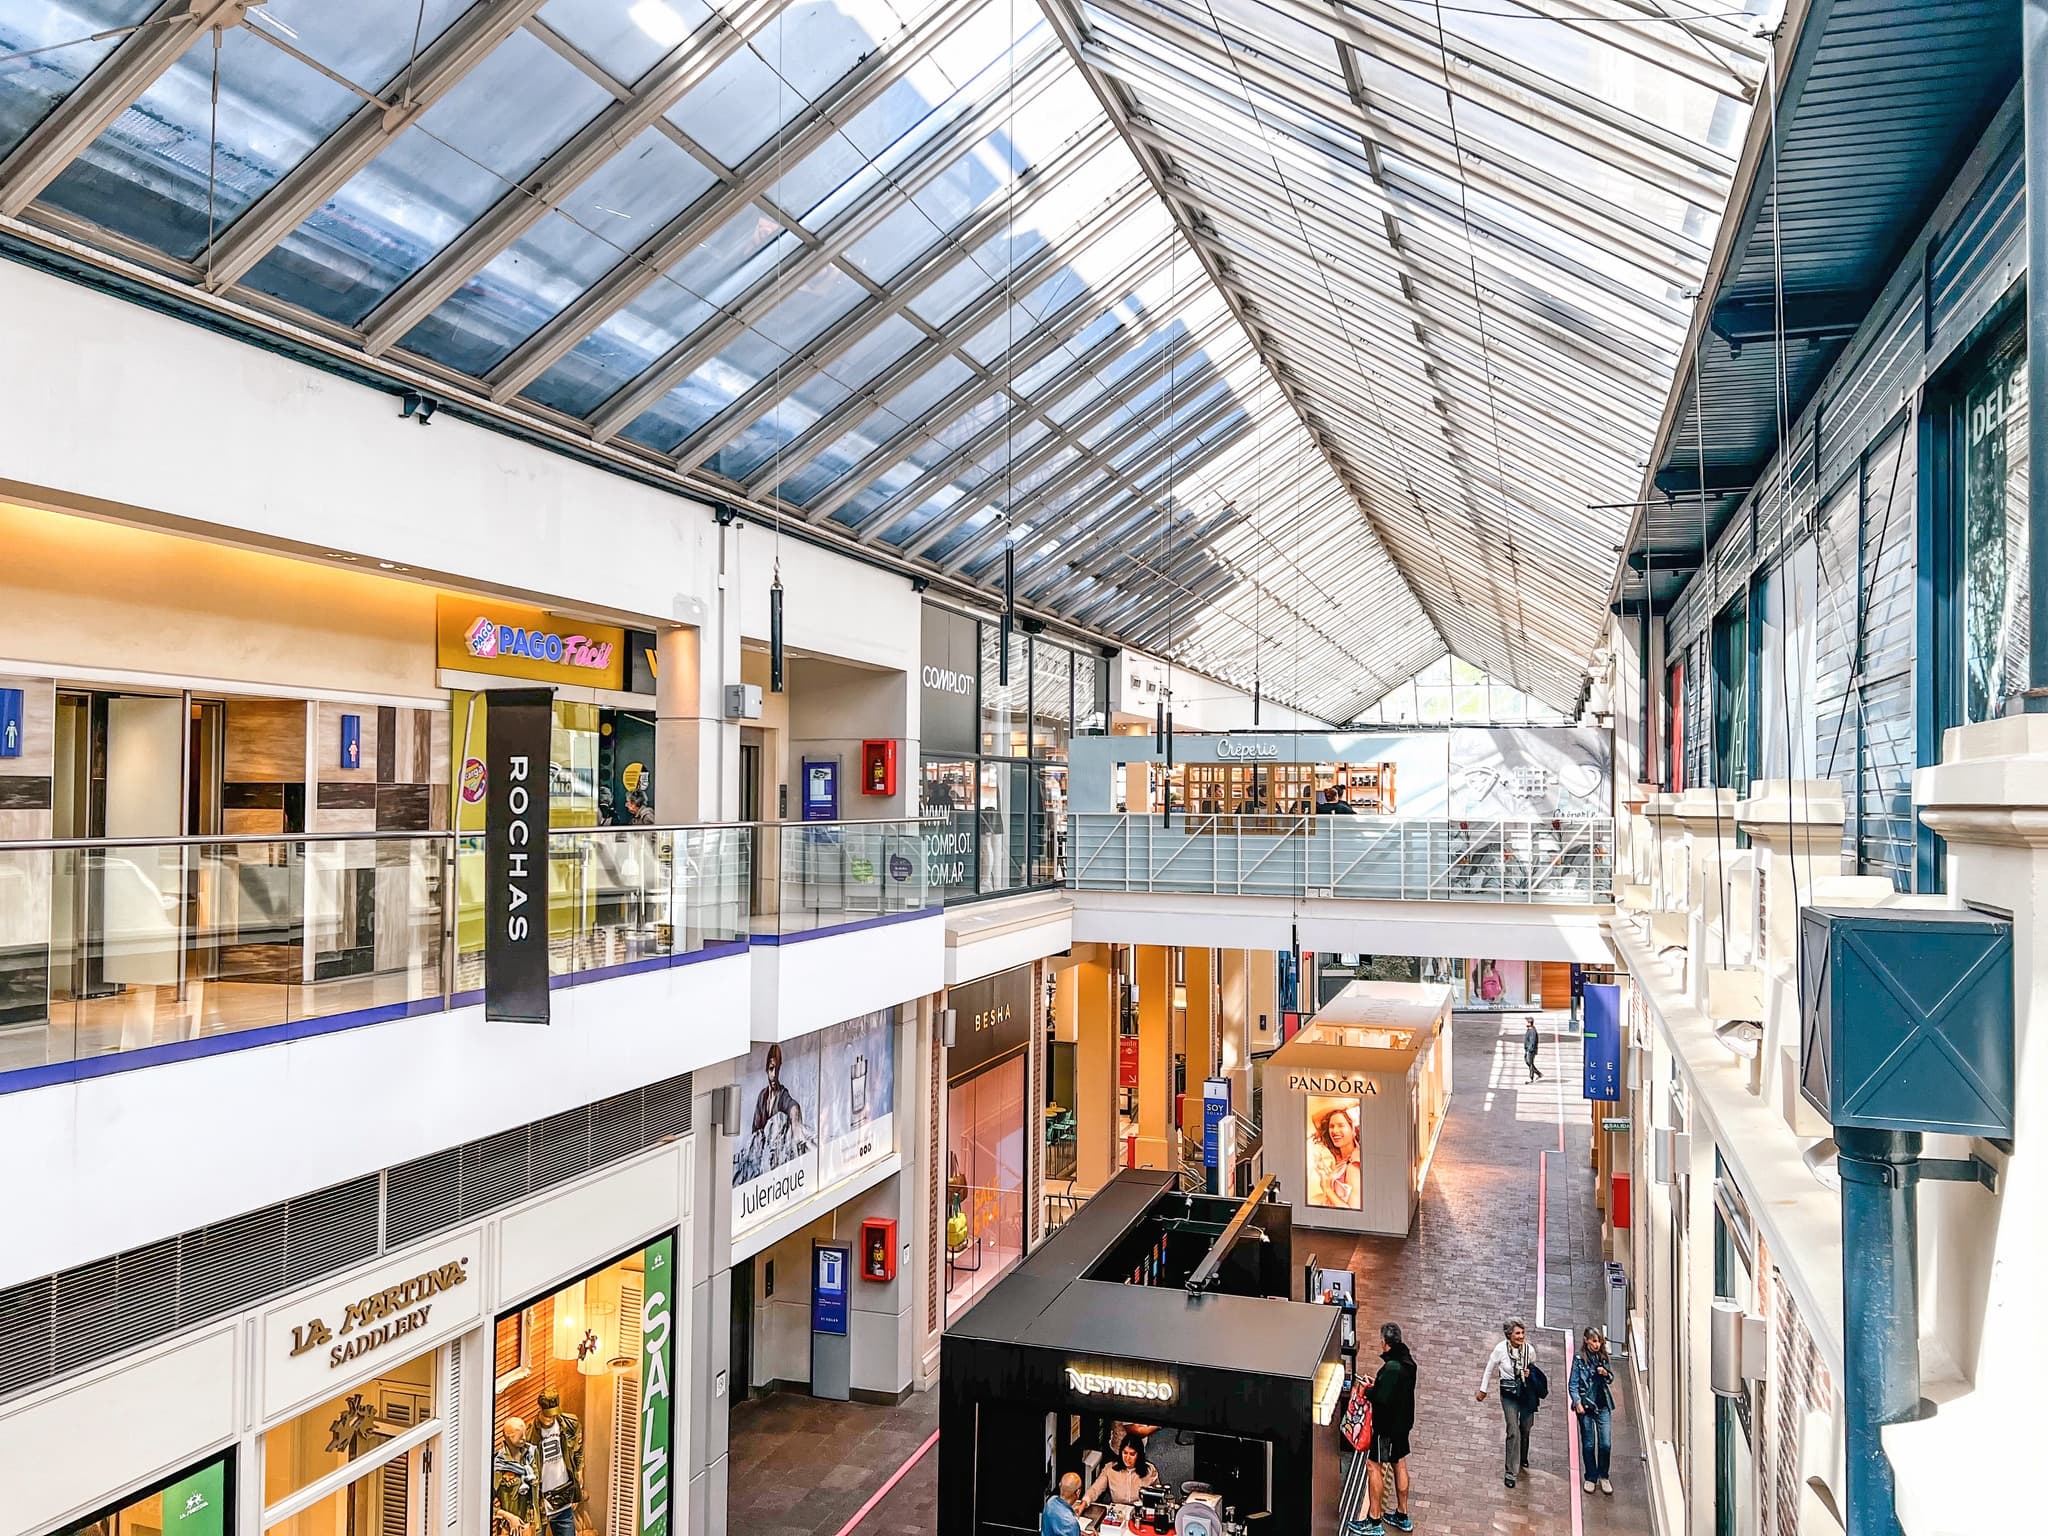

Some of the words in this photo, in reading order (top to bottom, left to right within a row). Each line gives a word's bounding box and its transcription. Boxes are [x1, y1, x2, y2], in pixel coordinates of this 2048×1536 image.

[500, 625, 562, 662] PAGO
[562, 635, 613, 670] Fácil
[923, 665, 972, 695] COMPLOT
[508, 756, 529, 942] ROCHAS
[975, 1003, 1011, 1032] BESHA
[1206, 1104, 1224, 1112] SOY
[1289, 1075, 1377, 1095] PANDORA
[740, 1168, 805, 1218] Juleriaque
[290, 1318, 332, 1357] LA
[339, 1260, 468, 1336] MARTINA
[330, 1303, 433, 1369] SADDLERY
[642, 1291, 671, 1531] SALE
